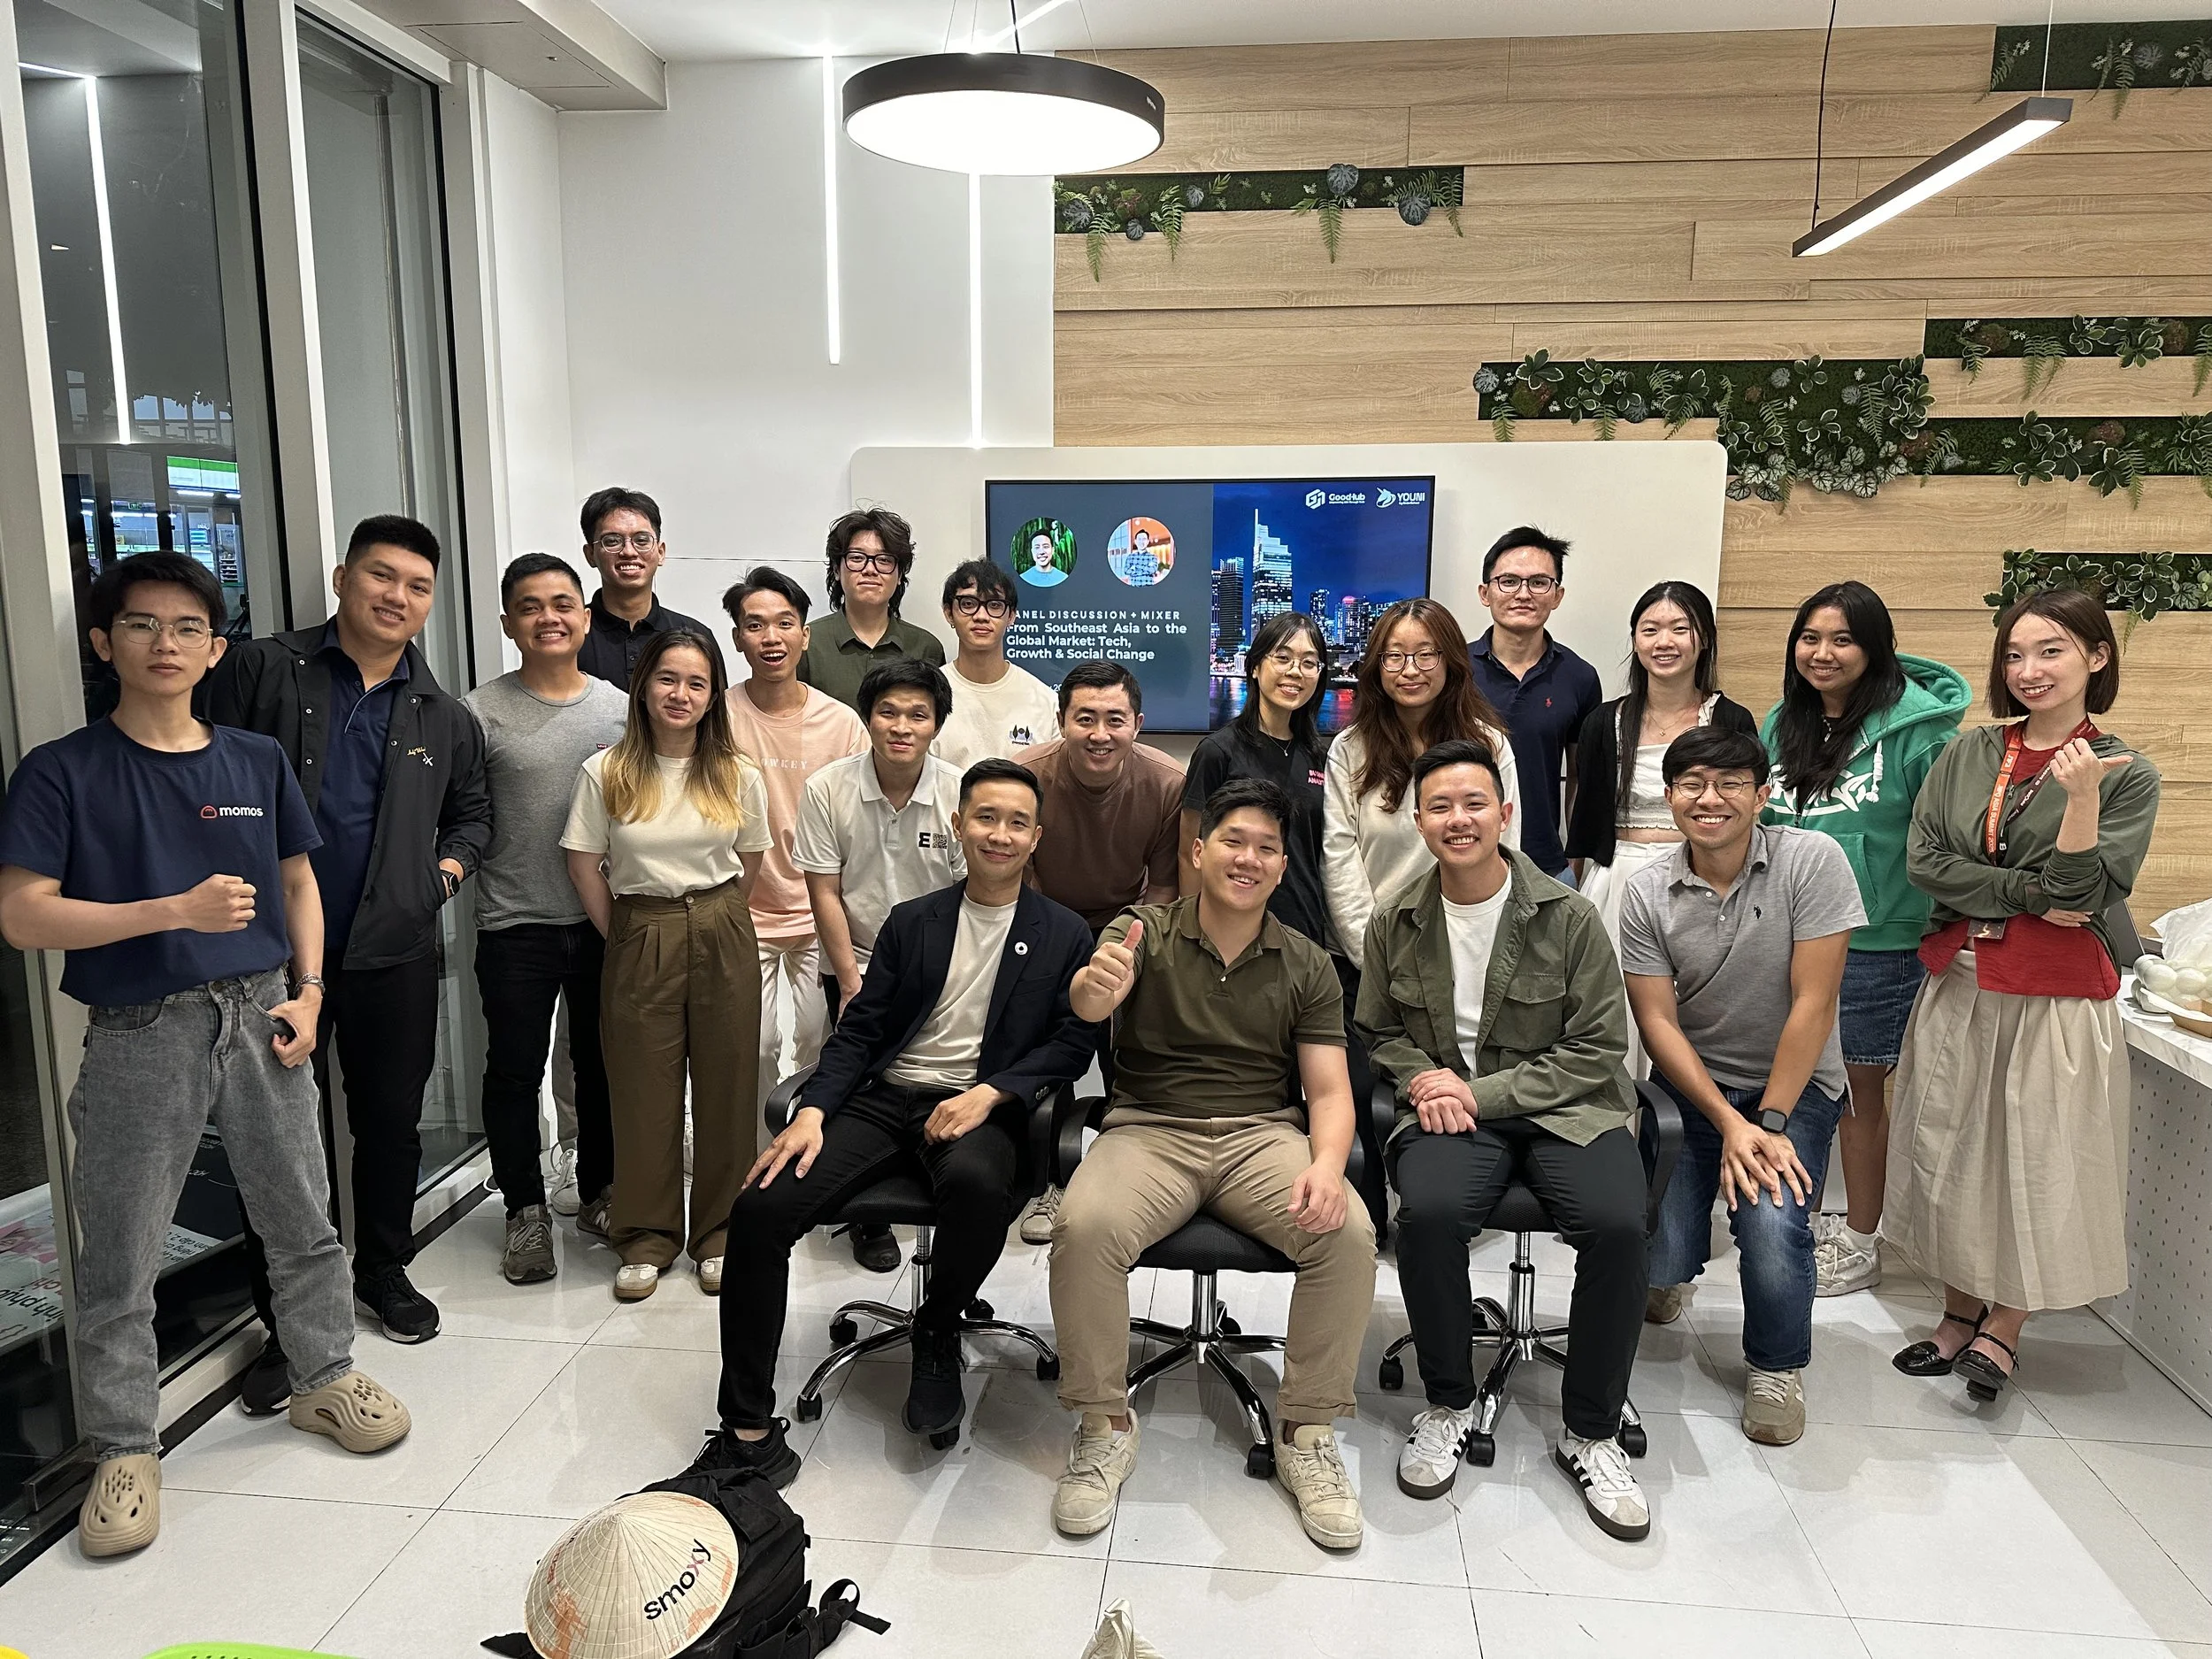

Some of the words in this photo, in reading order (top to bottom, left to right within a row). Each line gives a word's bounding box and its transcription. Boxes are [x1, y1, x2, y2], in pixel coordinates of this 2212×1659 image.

[1397, 492, 1425, 502] YOUNI
[1015, 610, 1046, 619] ANEL
[1049, 611, 1127, 619] DISCUSSION
[1141, 611, 1180, 620] MIXER
[1044, 622, 1108, 634] Southeast
[1113, 623, 1141, 634] Asia
[1146, 624, 1160, 634] to
[1164, 623, 1187, 634] the
[1006, 634, 1046, 646] Global
[1048, 634, 1096, 646] Market:
[1097, 635, 1132, 649] Tech,
[1006, 648, 1053, 659] Growth
[1055, 649, 1064, 659] &
[1066, 648, 1103, 660] Social
[1106, 649, 1156, 662] Change
[760, 757, 808, 771] OWKEY
[219, 805, 264, 817] momos
[1992, 798, 2001, 811] ASIA
[1987, 811, 1997, 836] SUMMIT
[643, 1538, 711, 1621] smoxy
